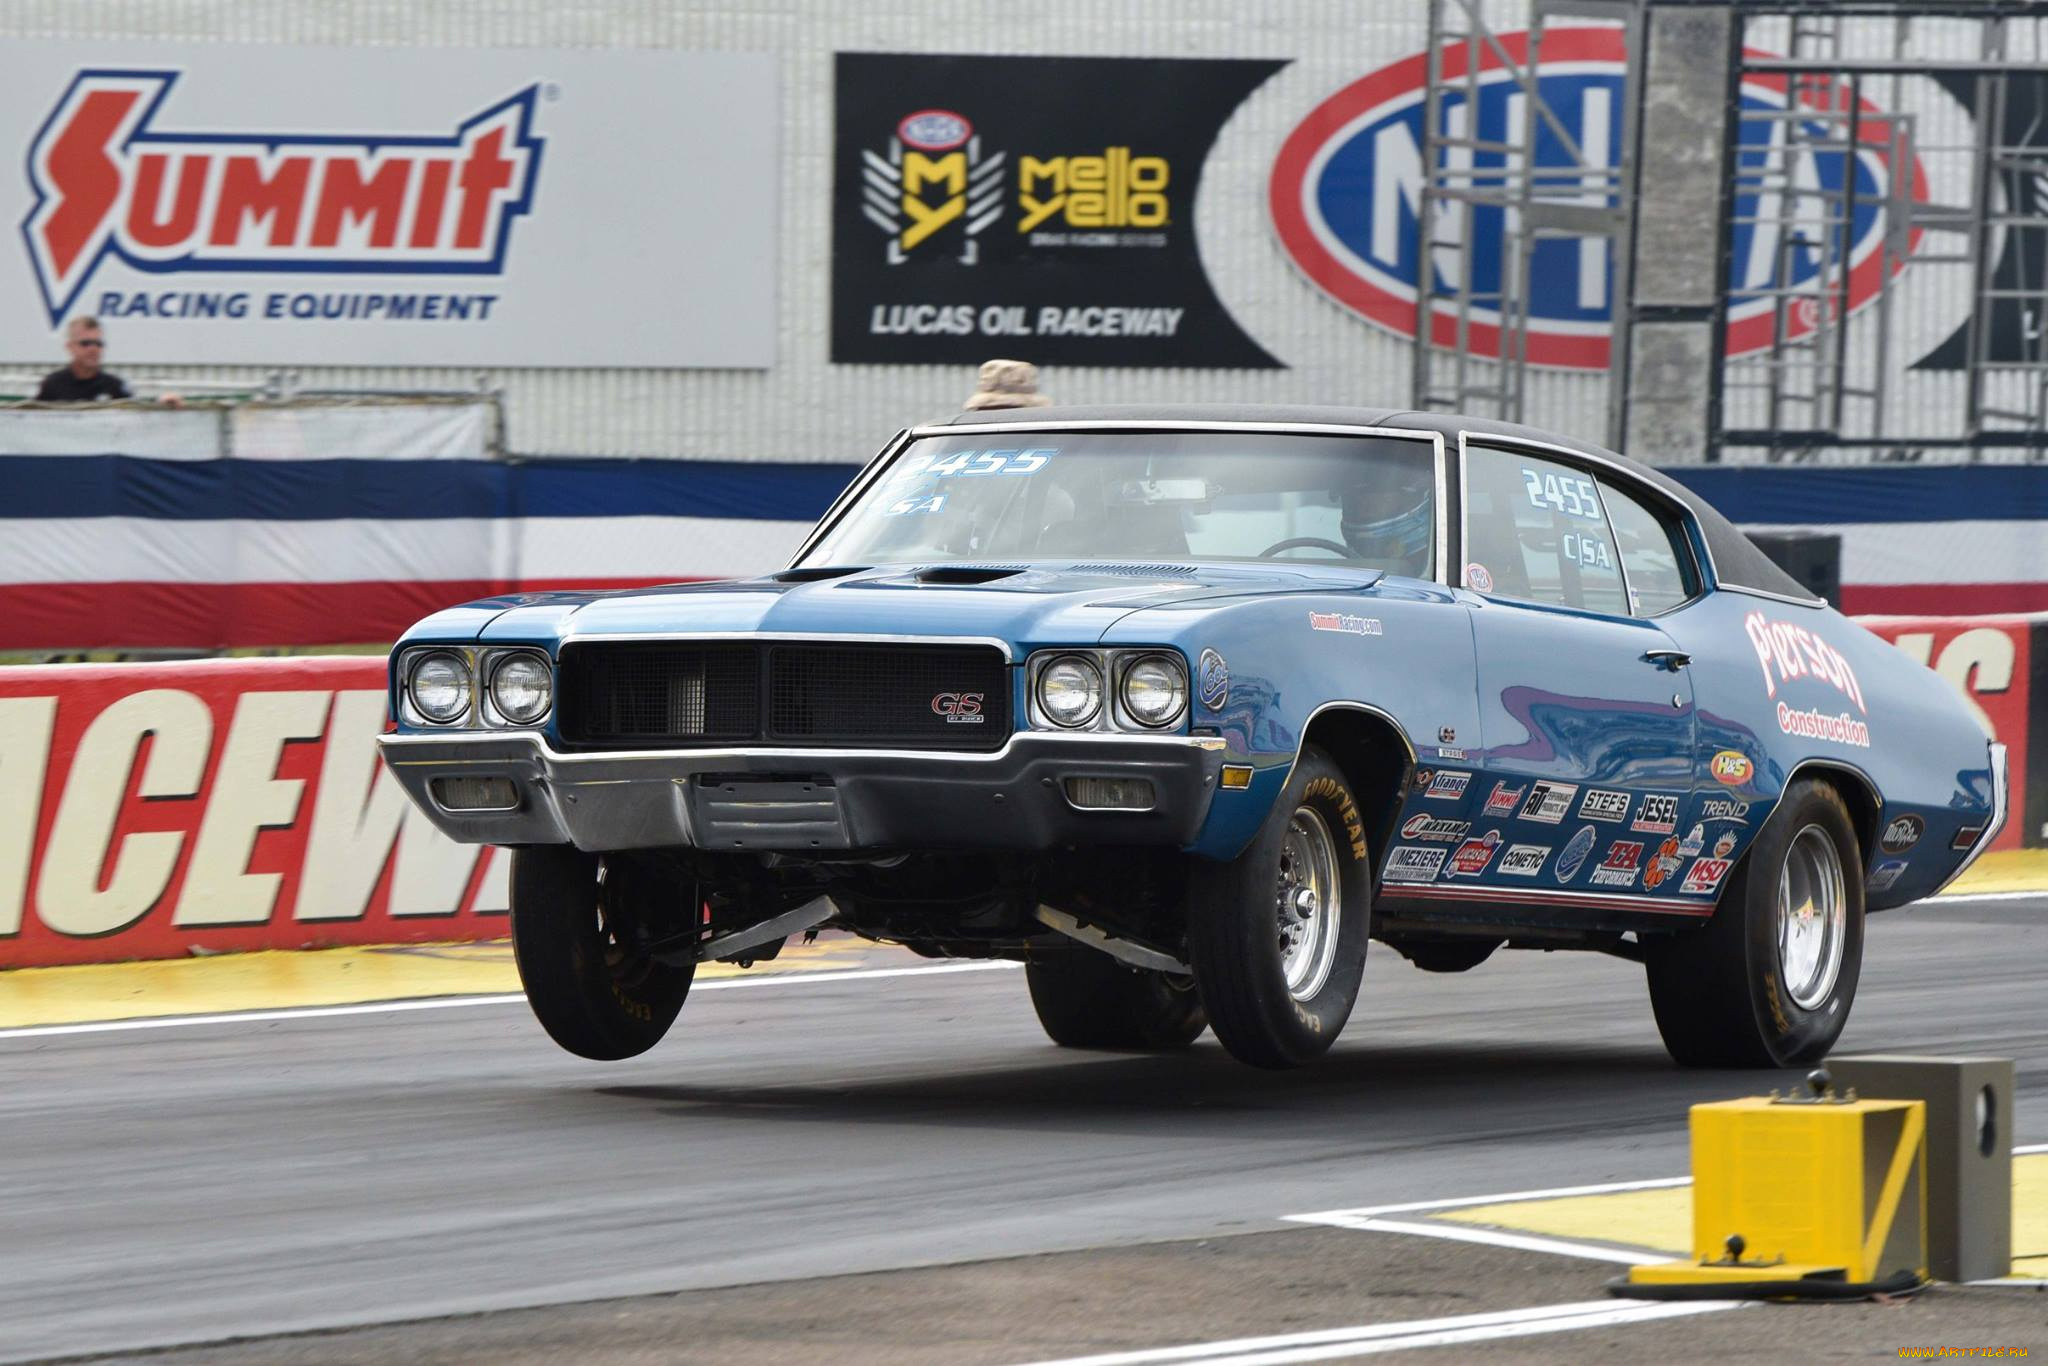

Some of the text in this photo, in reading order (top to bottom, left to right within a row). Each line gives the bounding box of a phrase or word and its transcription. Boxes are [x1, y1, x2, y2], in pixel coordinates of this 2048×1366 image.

[98, 292, 498, 320] RACING EQUIPMENT
[870, 304, 1184, 337] LUCAS OIL RACEWAY
[1521, 468, 1600, 519] 2455
[931, 692, 984, 715] GS
[1777, 702, 1869, 746] Construction
[1717, 756, 1747, 777] H&S
[1584, 791, 1628, 811] STEF'S
[1636, 797, 1678, 824] JESEL
[1701, 800, 1750, 817] TREND
[1303, 775, 1368, 861] GOODYEAR
[1396, 848, 1445, 868] MEZIERE
[1503, 851, 1545, 869] COMETIC
[1687, 860, 1729, 881] MSD
